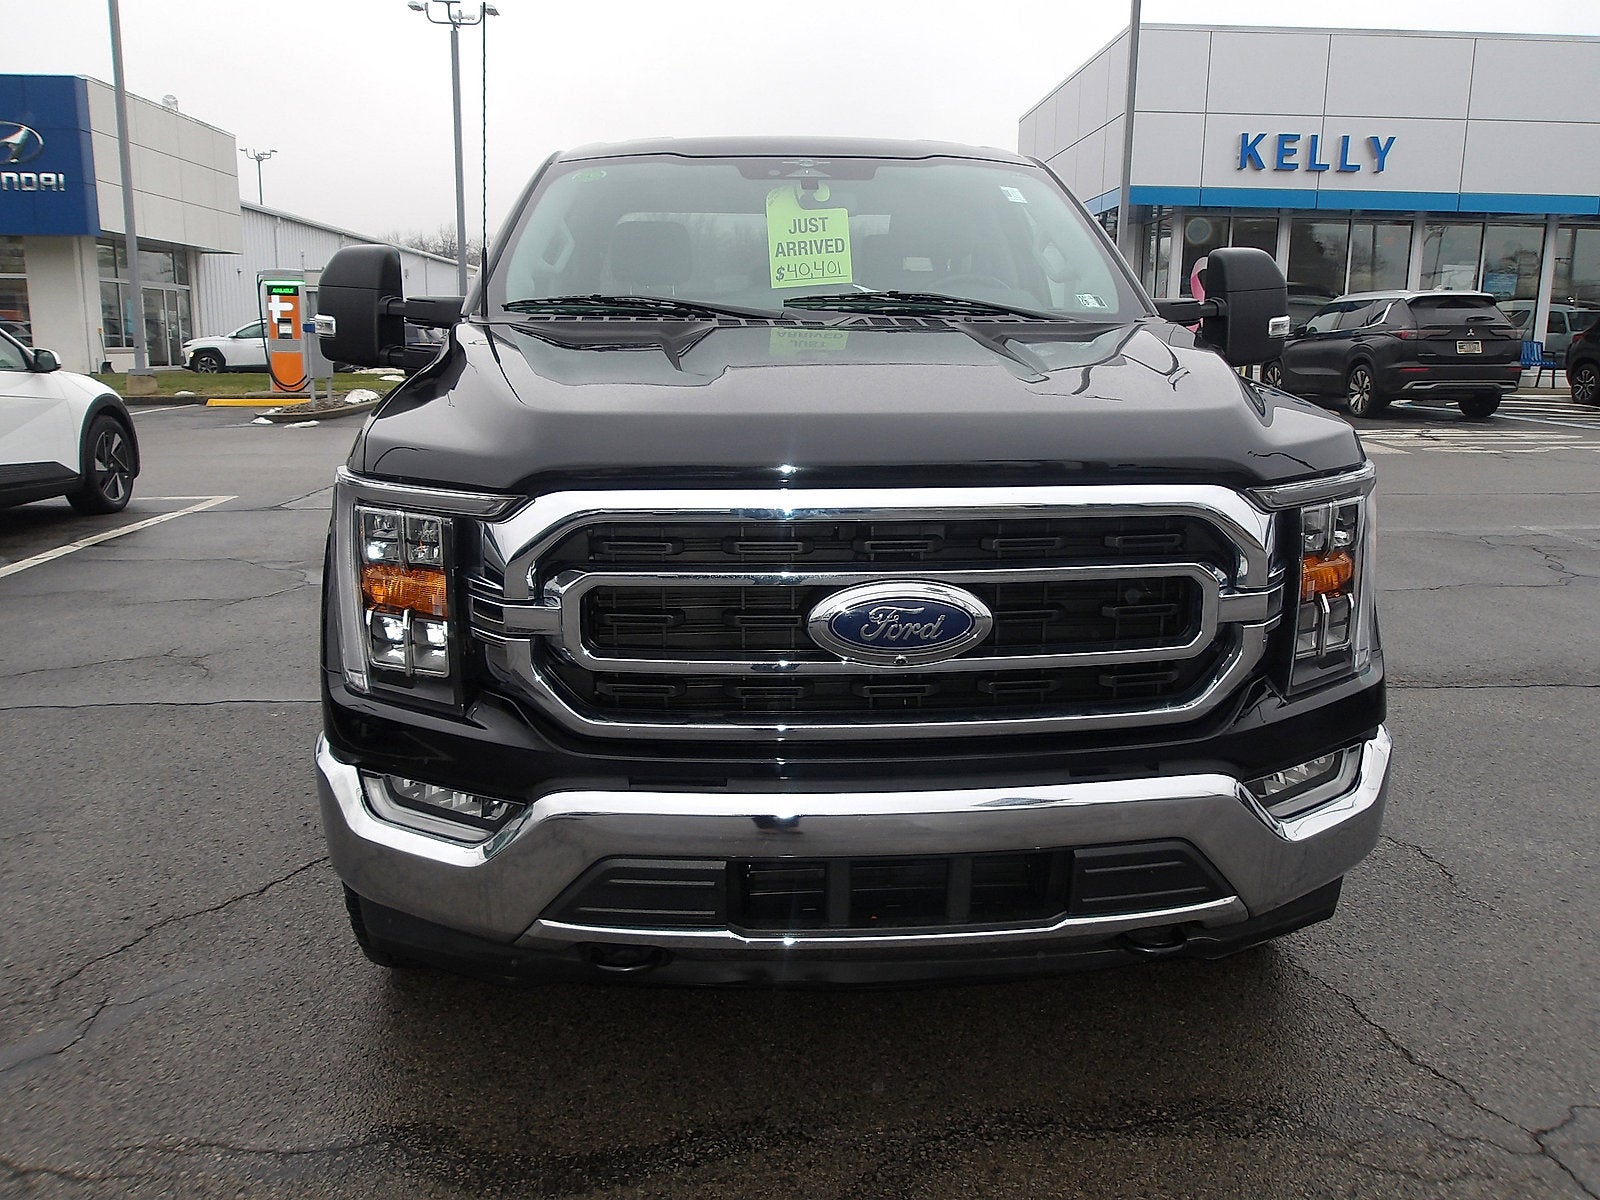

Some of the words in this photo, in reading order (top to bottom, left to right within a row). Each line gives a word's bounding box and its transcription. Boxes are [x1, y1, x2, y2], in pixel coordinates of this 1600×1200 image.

[1237, 132, 1396, 173] KELLY
[788, 217, 828, 234] JUST
[775, 238, 845, 257] ARRIVED
[775, 260, 841, 281] $40,401
[860, 605, 946, 641] Ford
